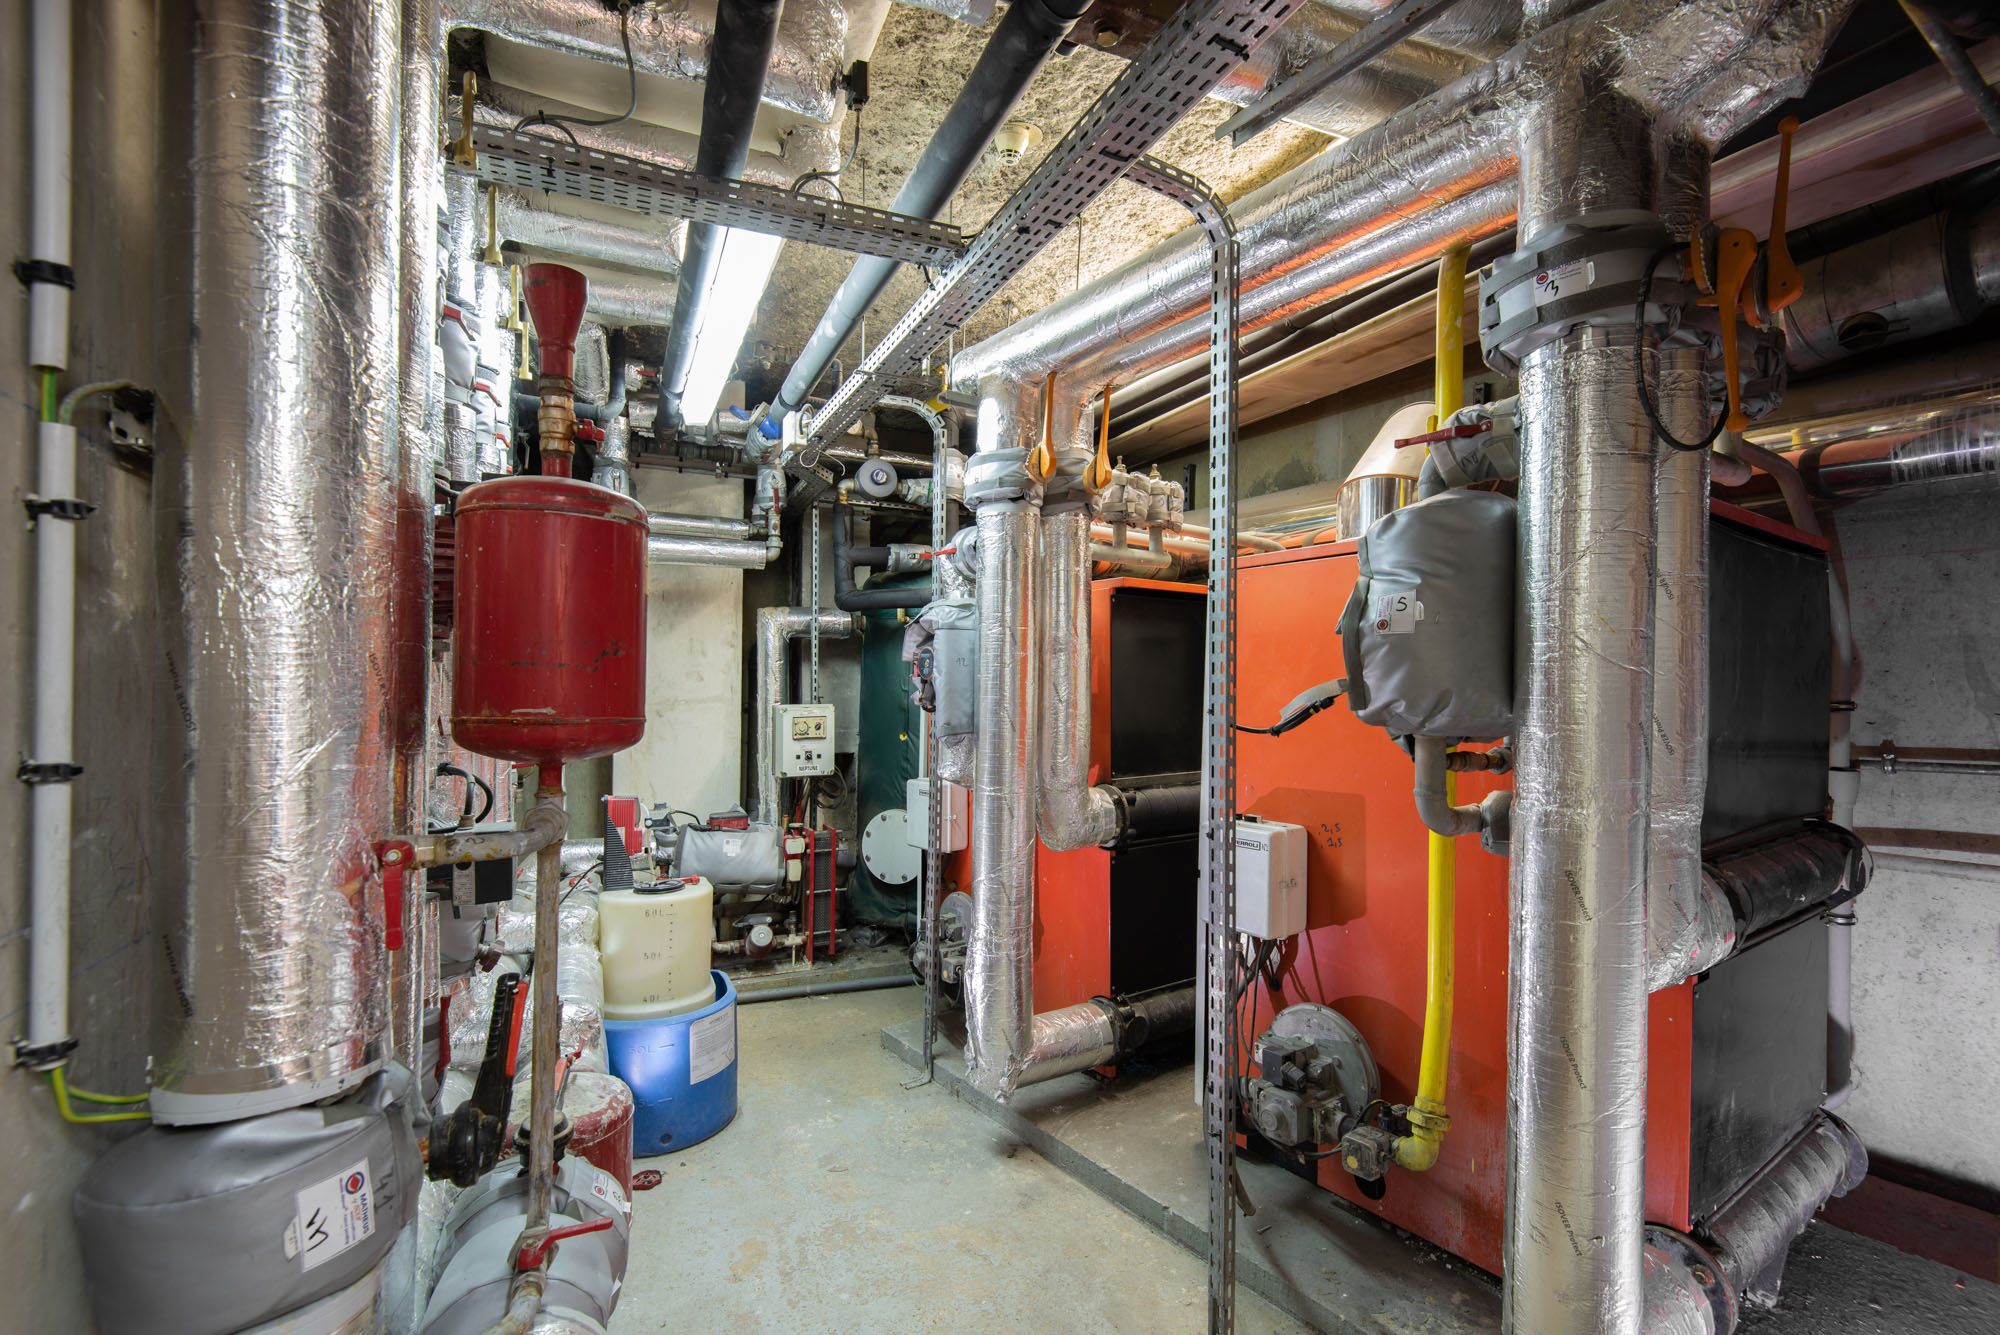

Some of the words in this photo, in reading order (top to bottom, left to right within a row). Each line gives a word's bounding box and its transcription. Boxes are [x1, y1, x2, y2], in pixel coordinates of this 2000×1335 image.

[1660, 733, 1675, 756] ISOVER
[1236, 839, 1259, 849] ERROLI
[1565, 870, 1581, 897] ISOVER
[1576, 896, 1593, 921] Protect
[1560, 1036, 1576, 1063] ISOVER
[1571, 1063, 1587, 1090] Protect
[360, 1193, 370, 1234] MATHEUS
[1555, 1202, 1571, 1229] ISOVER
[1566, 1230, 1582, 1256] Protect
